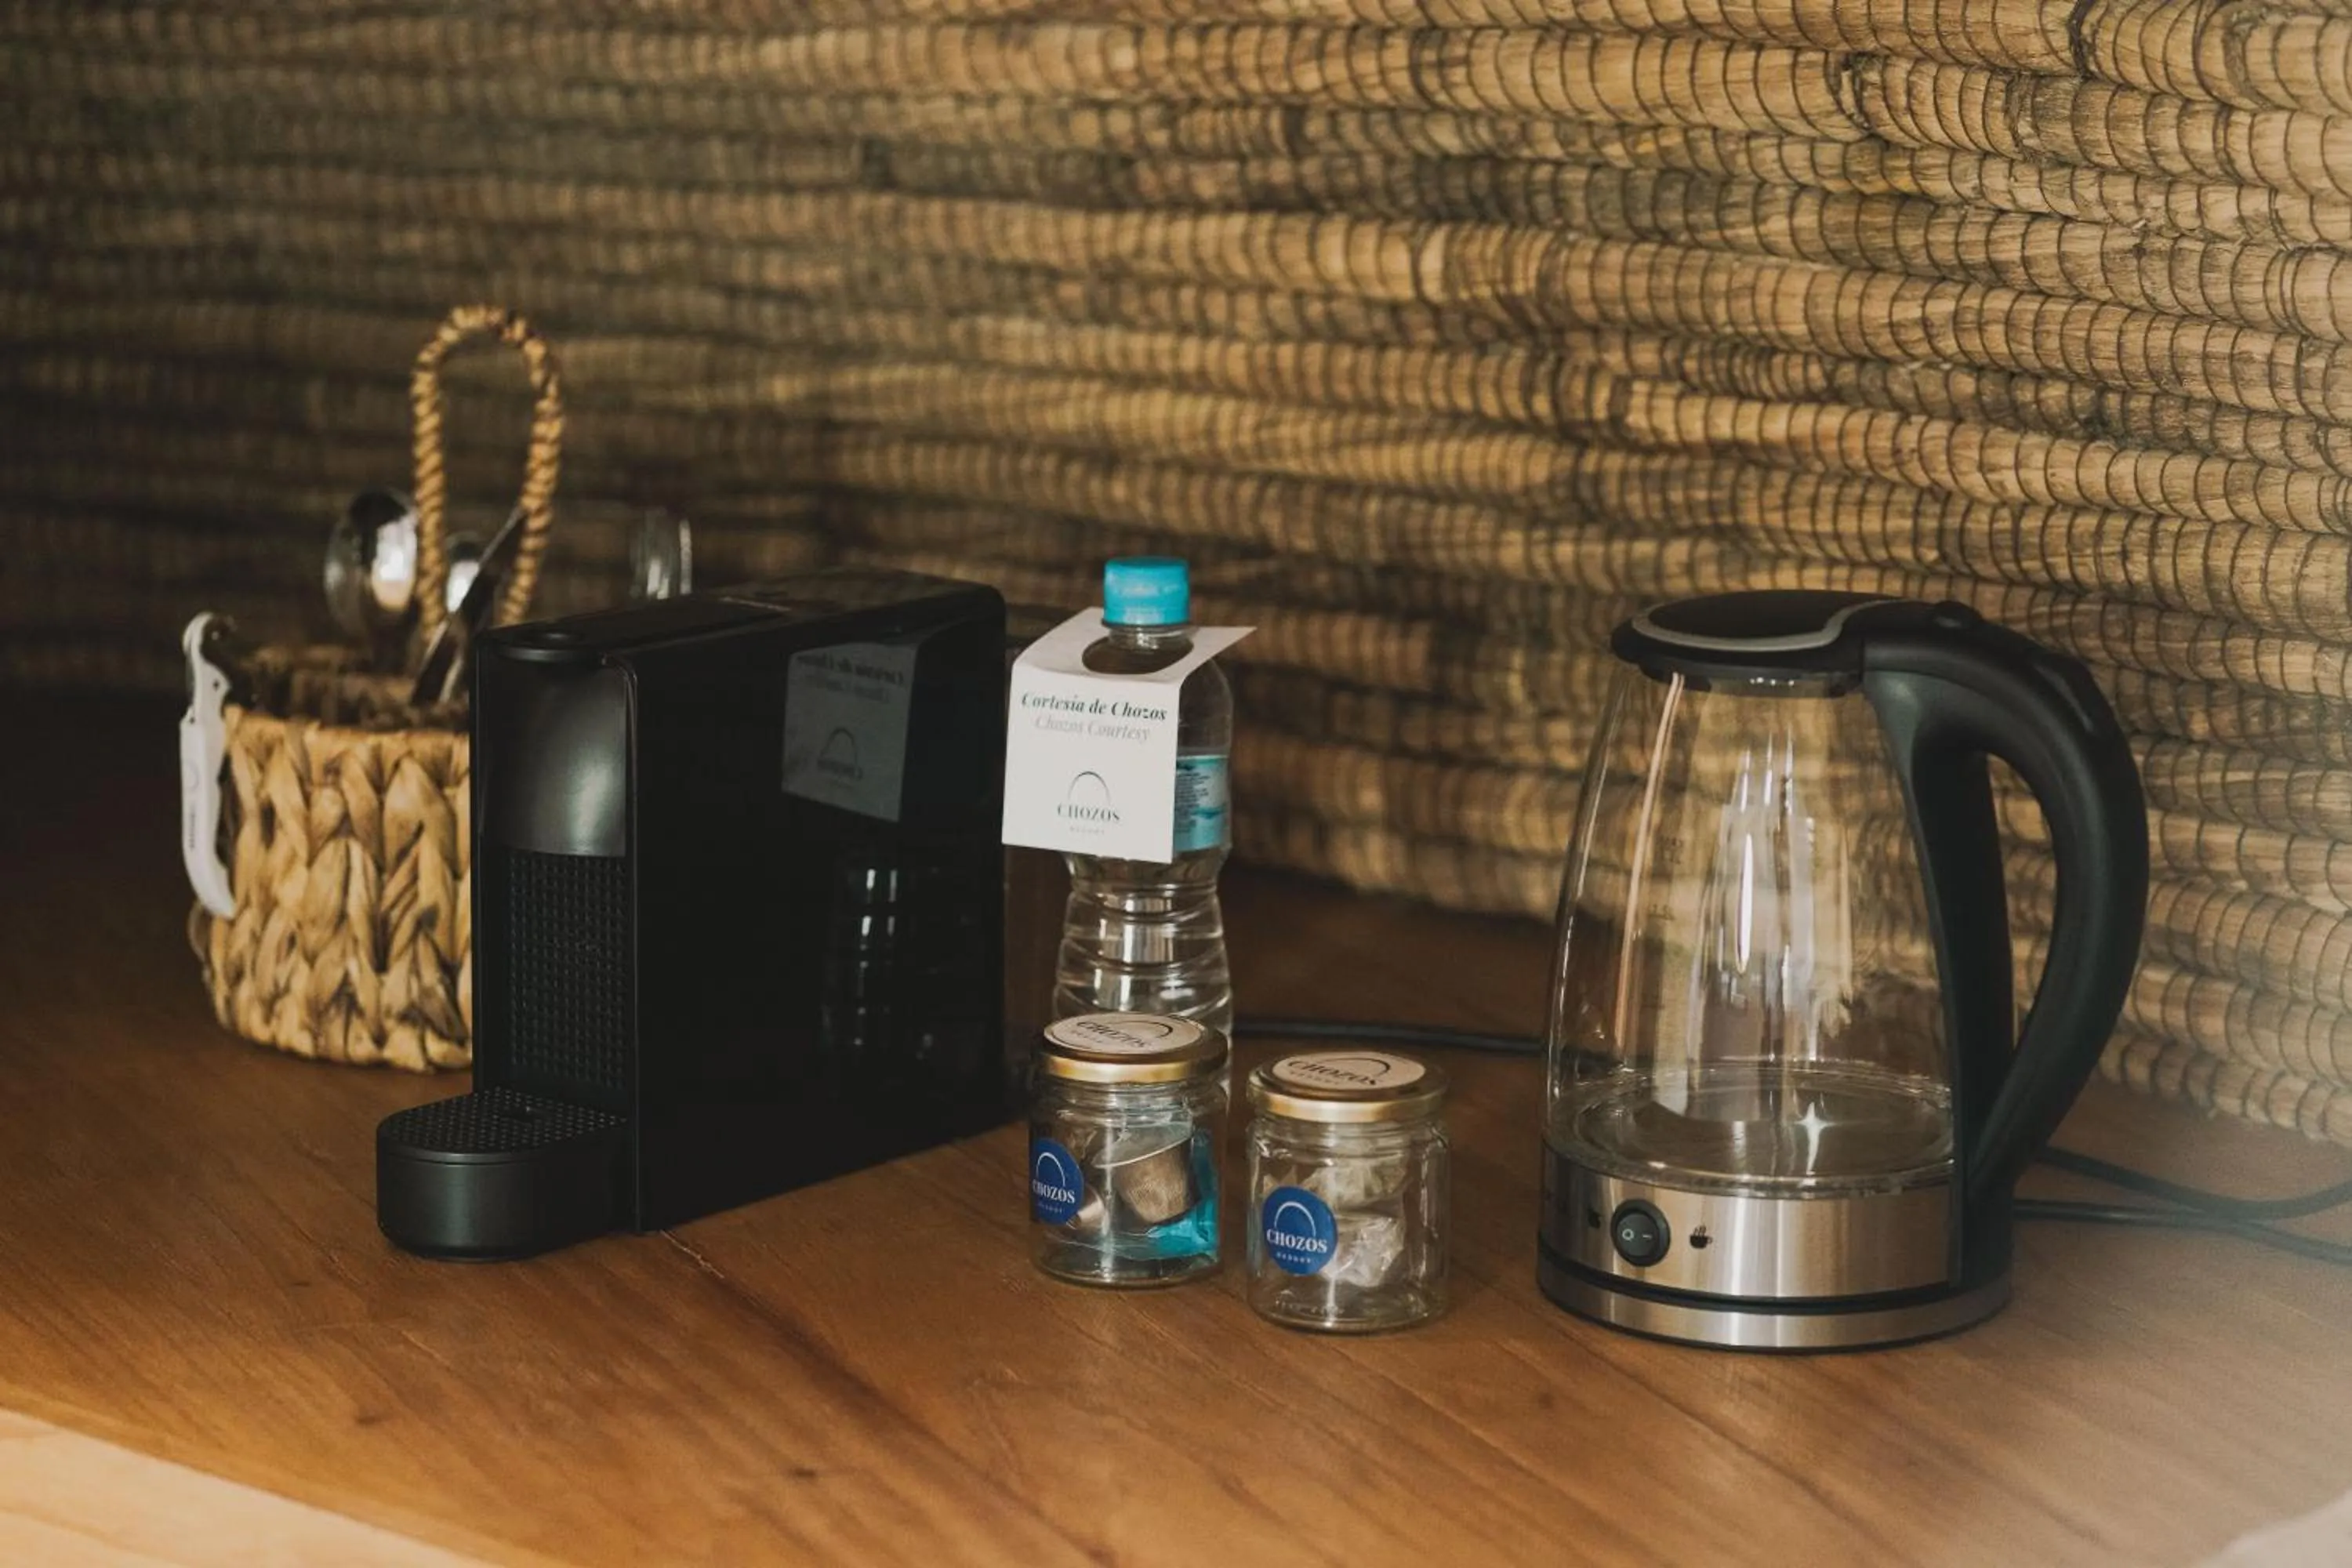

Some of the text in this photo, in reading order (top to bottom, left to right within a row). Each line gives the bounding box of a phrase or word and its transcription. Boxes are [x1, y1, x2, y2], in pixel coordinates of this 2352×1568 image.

[1089, 699, 1107, 715] de
[1111, 702, 1167, 720] Chozos
[1035, 714, 1150, 743] Chozos Courtesy
[1057, 802, 1120, 823] CHOZOS
[1033, 1178, 1075, 1204] CHOZOS
[1266, 1229, 1327, 1254] CHOZOS
